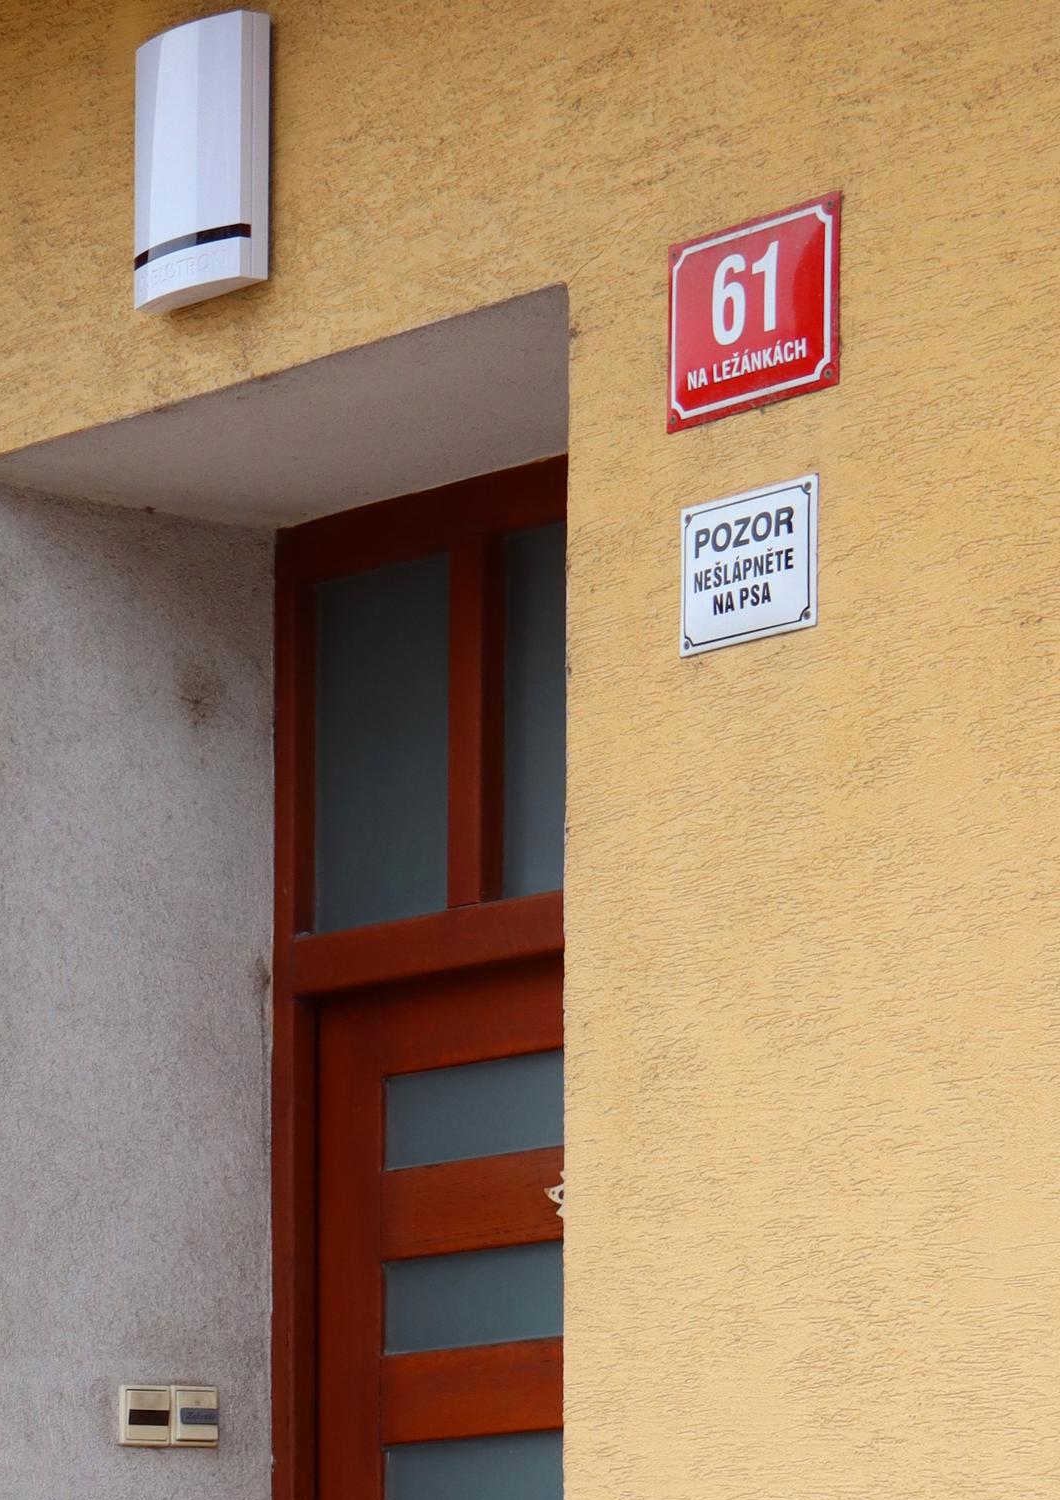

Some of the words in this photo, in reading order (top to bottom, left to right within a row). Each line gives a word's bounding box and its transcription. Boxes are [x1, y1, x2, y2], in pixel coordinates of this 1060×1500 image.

[711, 240, 779, 346] 61
[687, 370, 709, 391] NA
[713, 338, 807, 382] LEŽÁNKÁCH
[694, 506, 795, 558] POZOR
[693, 547, 795, 593] NEŠLÁPNĚTE
[713, 592, 736, 615] NA
[739, 588, 772, 608] PSA
